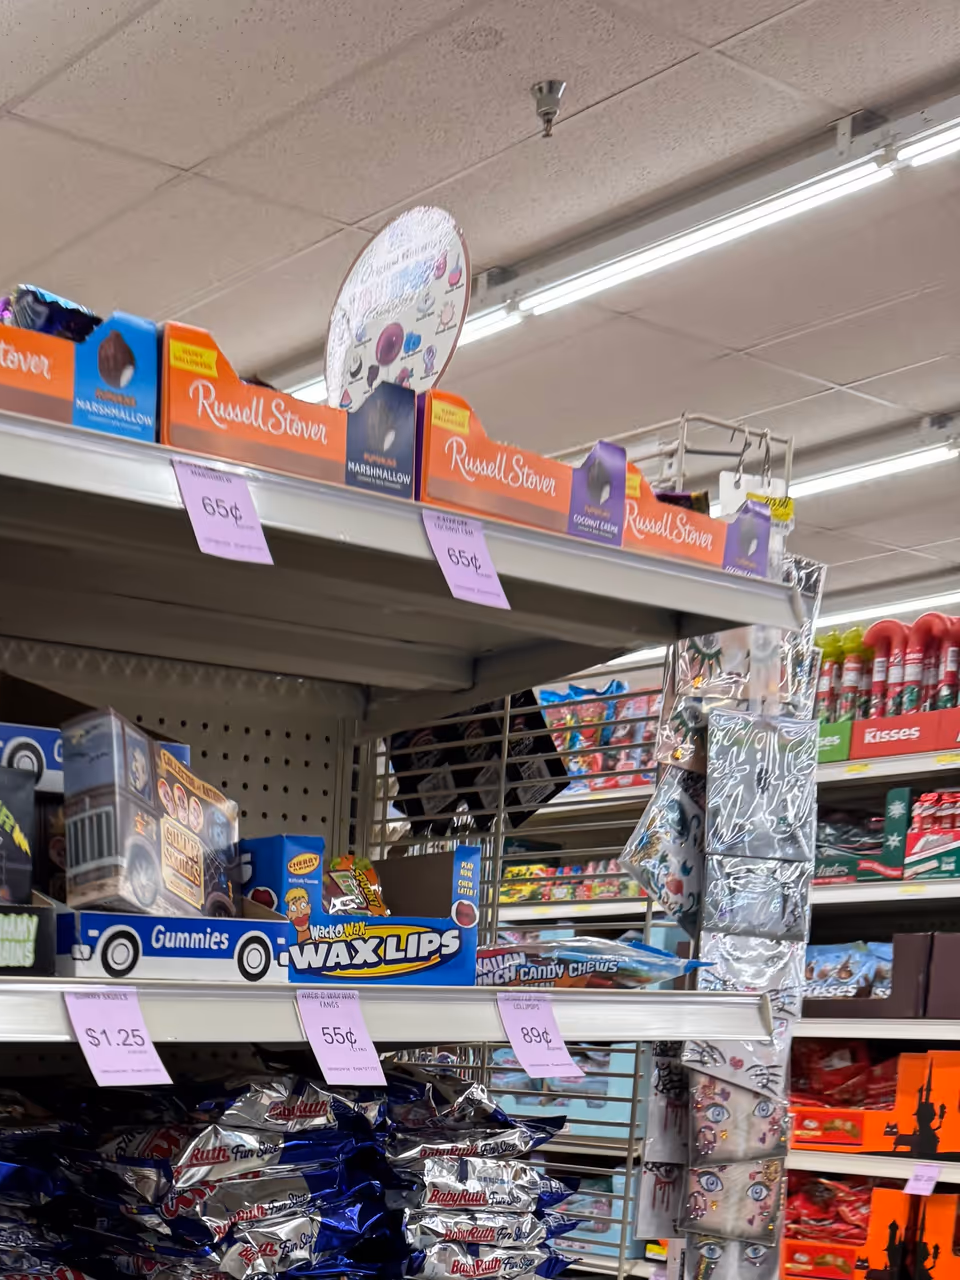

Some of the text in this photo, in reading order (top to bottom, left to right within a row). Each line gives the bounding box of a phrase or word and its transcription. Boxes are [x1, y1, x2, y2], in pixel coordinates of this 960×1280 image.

[75, 398, 154, 428] MARSHMALLOW
[189, 378, 328, 446] Russell Stover
[347, 460, 411, 486] MARSHMALLOW
[445, 436, 557, 497] Russell Stover
[201, 495, 243, 523] 65¢
[623, 499, 713, 551] Russell Stover
[447, 547, 482, 573] 65¢
[288, 854, 320, 869] CHERRY
[353, 868, 381, 908] SPOOKY
[151, 924, 229, 951] Gummies
[289, 929, 461, 970] WAX LIPS
[520, 962, 564, 981] CANDY
[568, 961, 619, 979] CHEWS
[86, 1027, 145, 1048] $1.25
[321, 1026, 358, 1048] 55¢
[520, 1027, 552, 1045] 89¢
